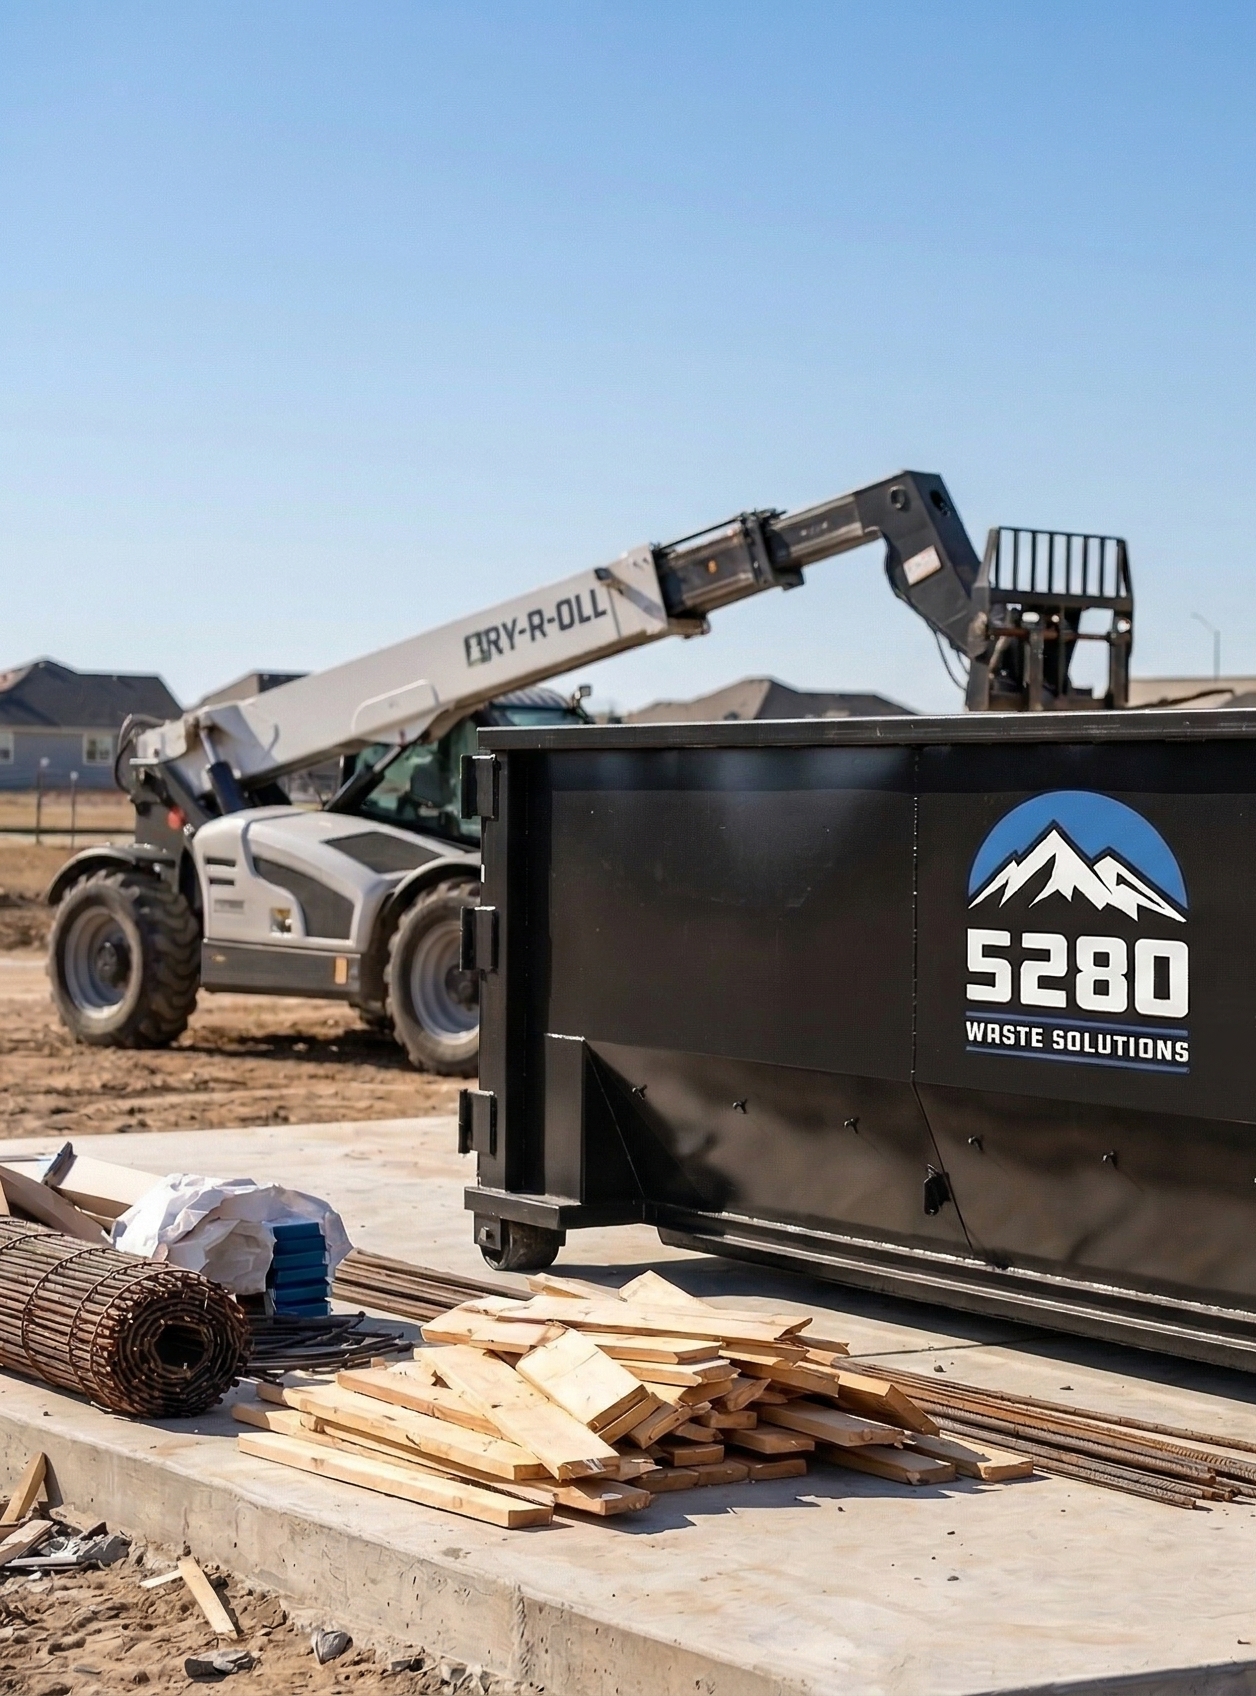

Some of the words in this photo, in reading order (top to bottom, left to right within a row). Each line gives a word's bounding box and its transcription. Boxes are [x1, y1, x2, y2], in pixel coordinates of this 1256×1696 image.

[966, 928, 1189, 1018] 5280
[965, 1021, 1044, 1048] WASTE
[1052, 1029, 1190, 1063] SOLUTIONS
